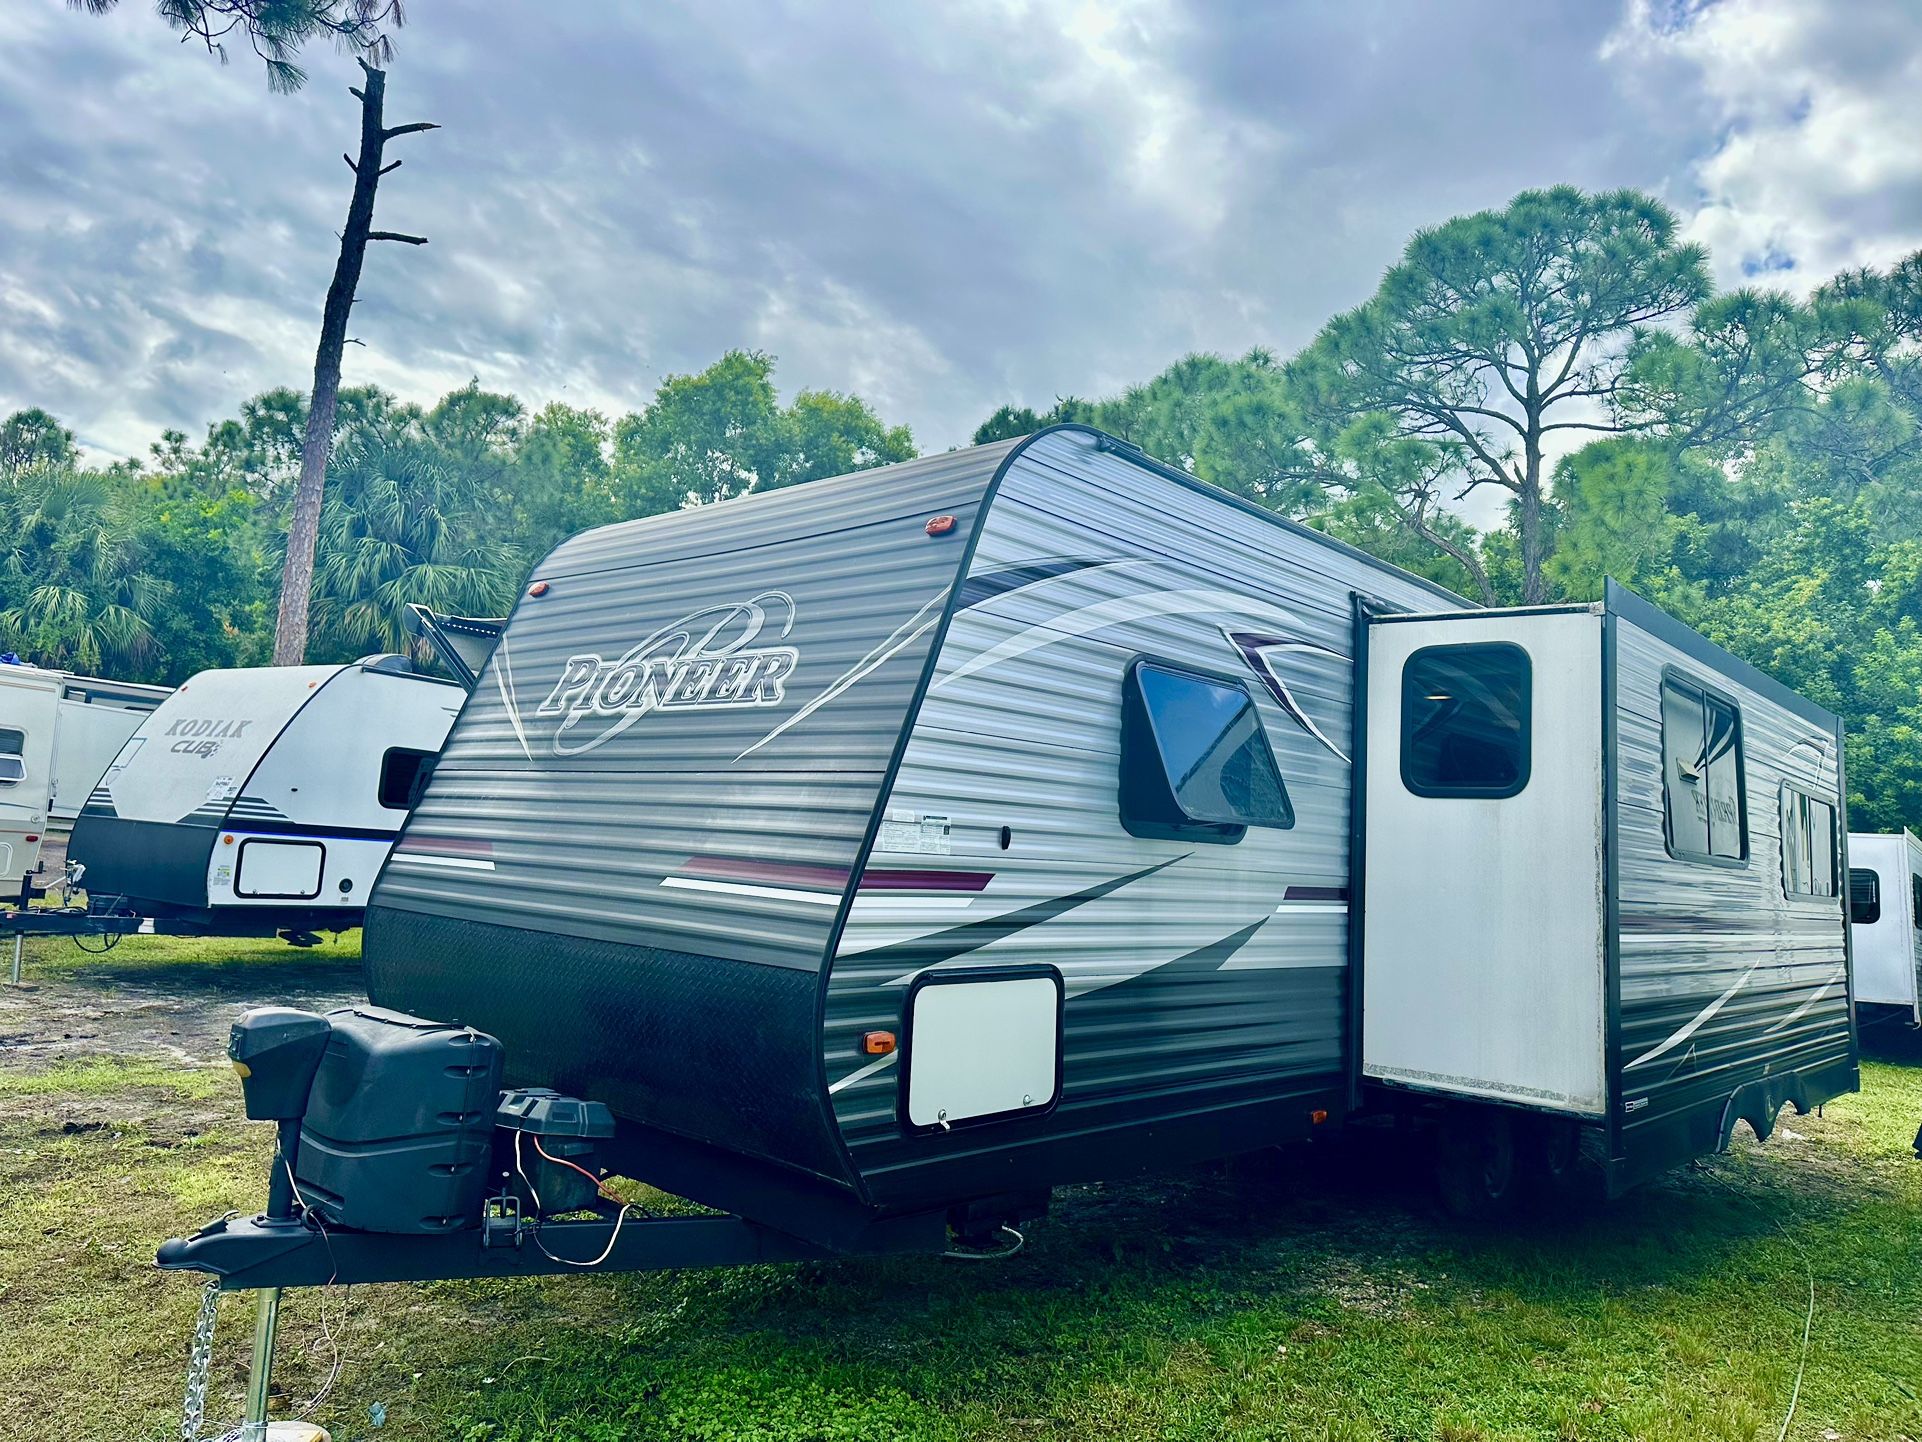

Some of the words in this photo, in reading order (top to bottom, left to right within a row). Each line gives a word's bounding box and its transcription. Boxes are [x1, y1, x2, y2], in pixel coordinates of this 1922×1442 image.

[537, 649, 798, 714] PIONEER
[164, 719, 253, 738] KODIAK
[170, 740, 219, 757] CUB
